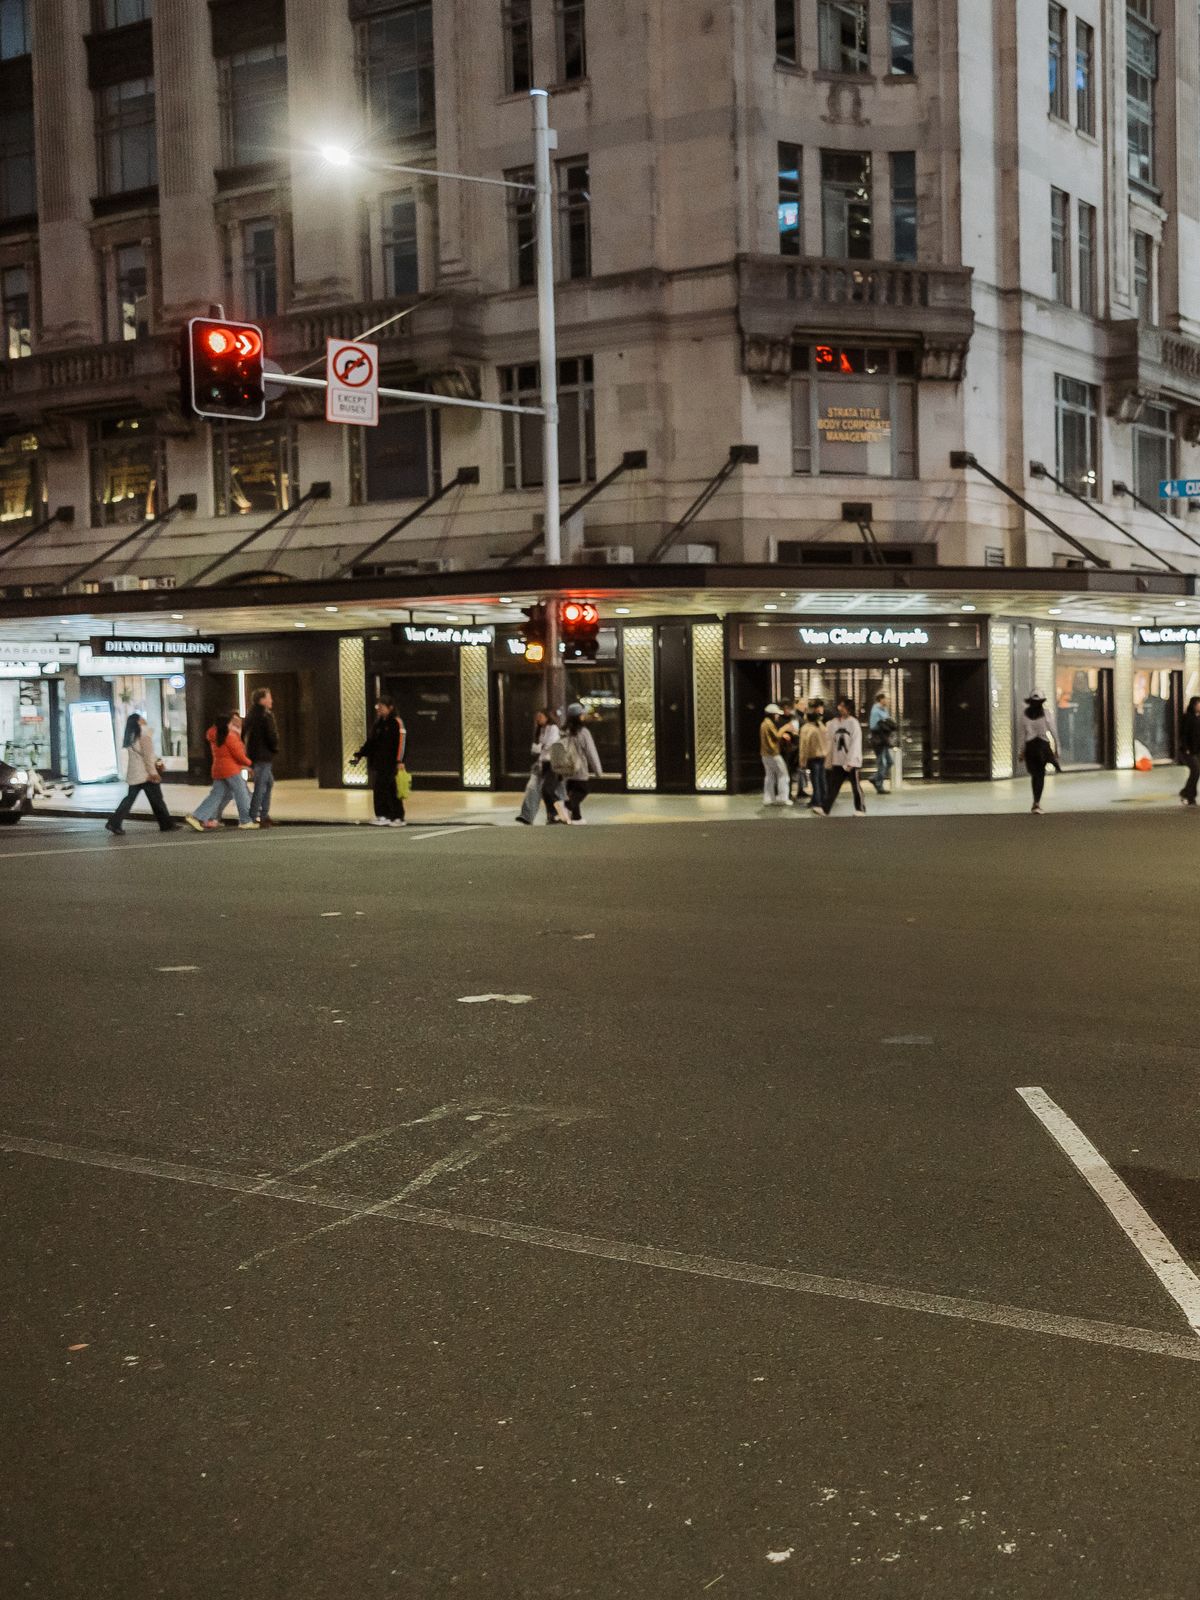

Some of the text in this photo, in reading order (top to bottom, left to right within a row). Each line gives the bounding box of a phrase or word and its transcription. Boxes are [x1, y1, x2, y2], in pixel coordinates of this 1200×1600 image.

[337, 395, 367, 404] EXCEPT
[339, 403, 366, 413] BUSES
[405, 627, 426, 641] Van
[799, 628, 929, 647] Van Cleef & Arpels
[105, 641, 215, 653] DILWORTH BUILDING
